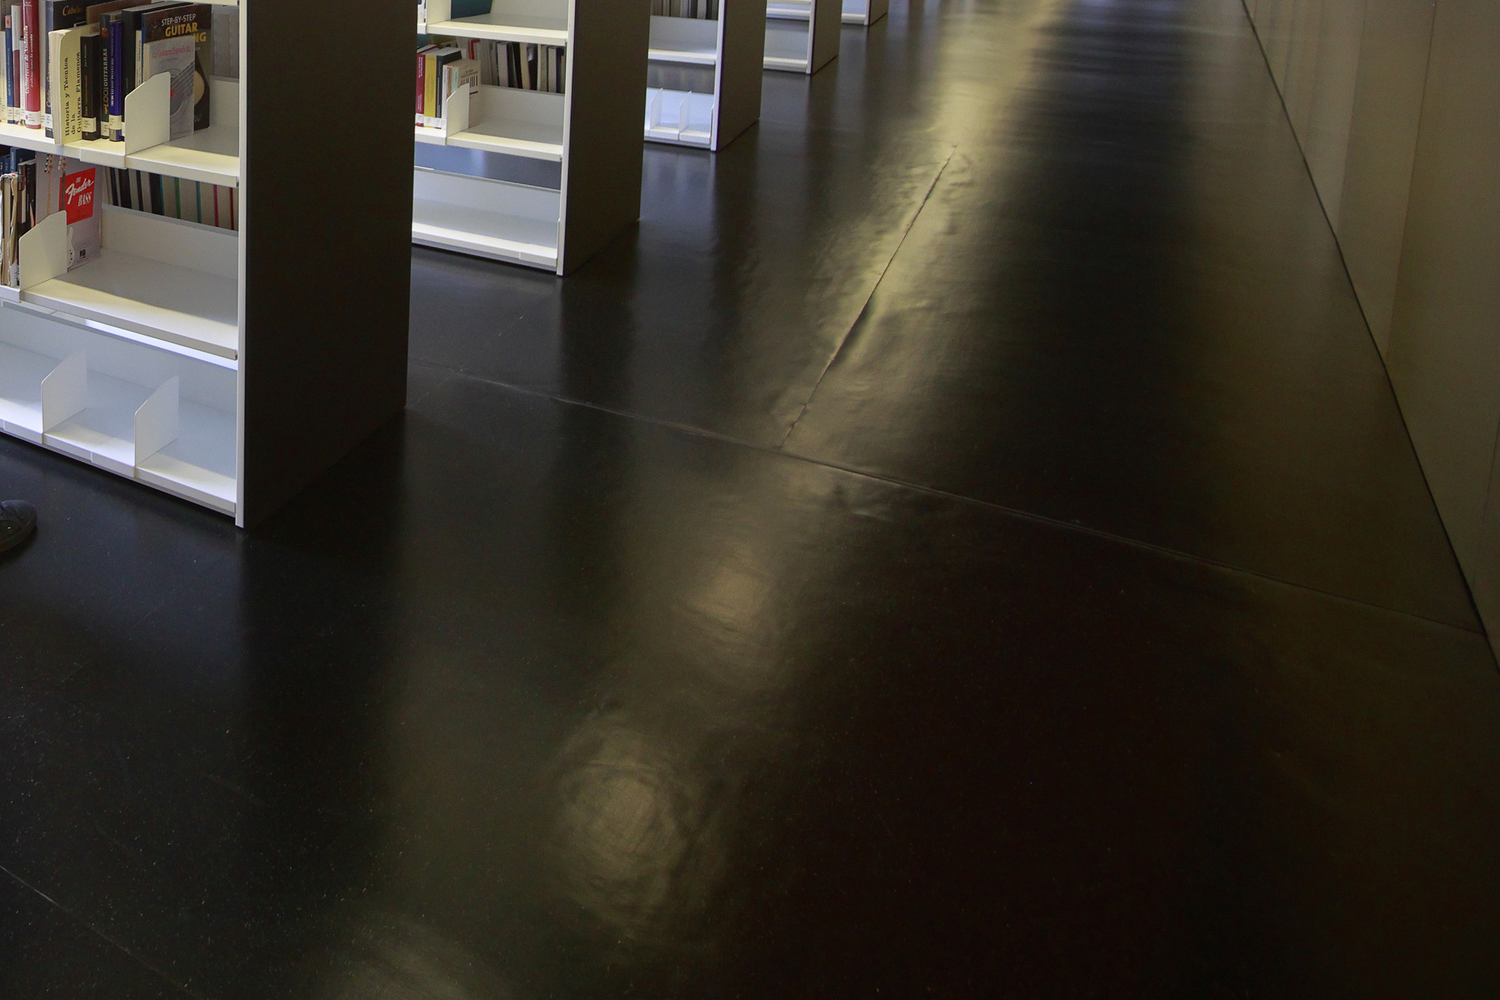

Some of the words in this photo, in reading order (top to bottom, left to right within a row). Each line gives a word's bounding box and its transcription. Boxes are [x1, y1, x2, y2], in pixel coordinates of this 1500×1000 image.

[161, 13, 196, 26] STEP-BY-STEP
[165, 22, 198, 37] GUITAR
[71, 113, 75, 122] la
[71, 125, 75, 135] de
[65, 178, 94, 205] Fender
[78, 191, 92, 207] BASS
